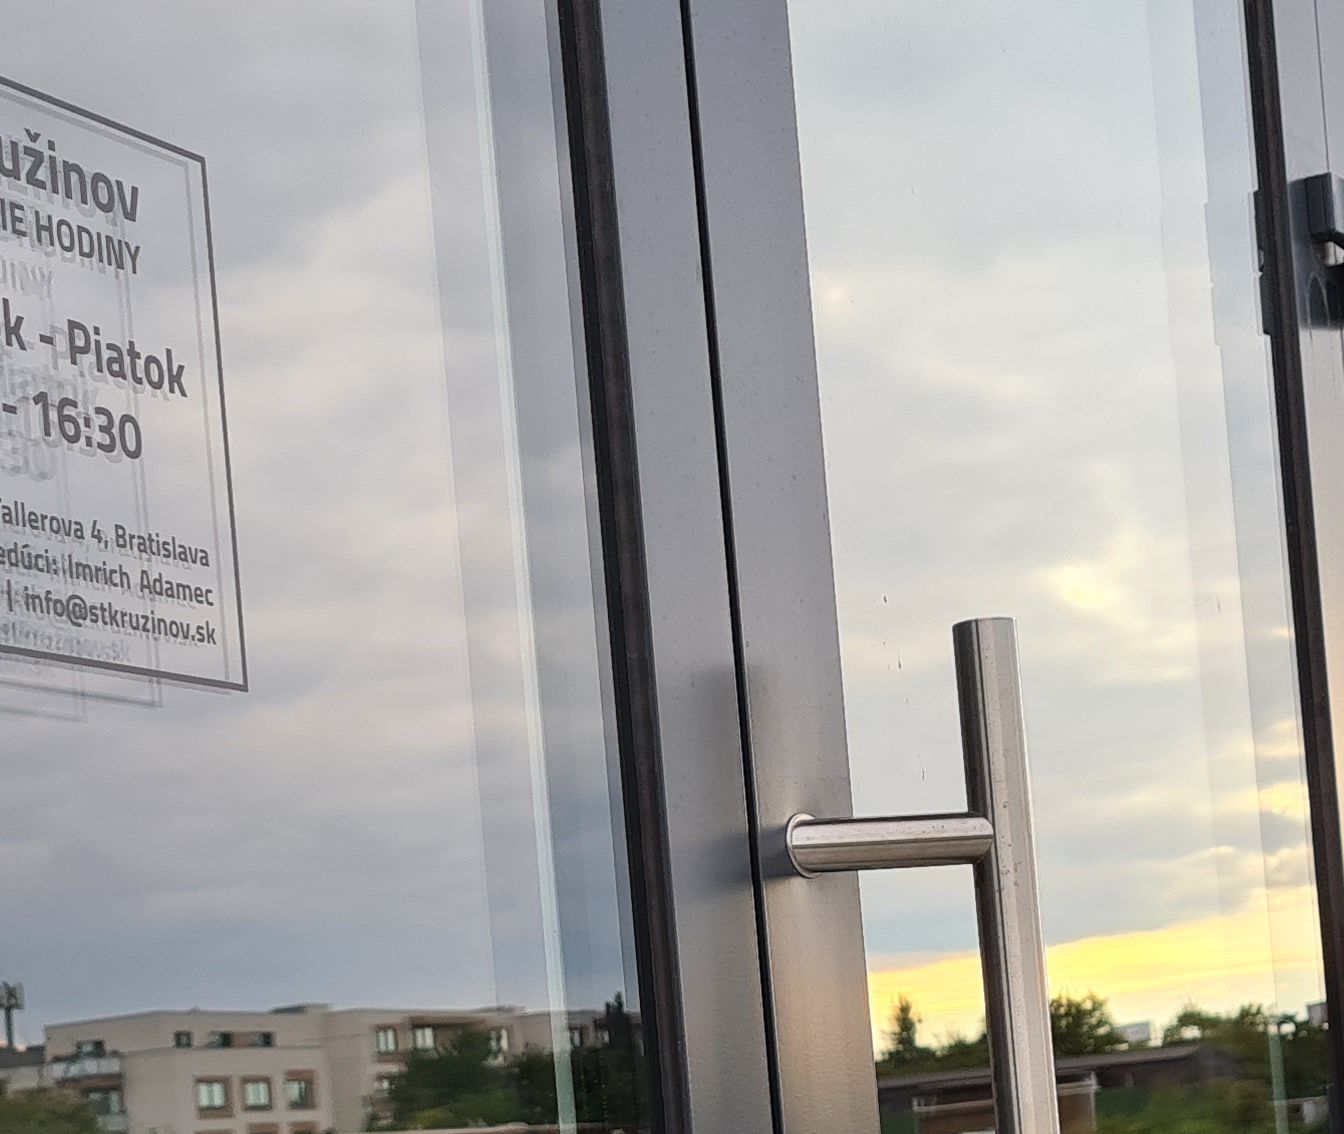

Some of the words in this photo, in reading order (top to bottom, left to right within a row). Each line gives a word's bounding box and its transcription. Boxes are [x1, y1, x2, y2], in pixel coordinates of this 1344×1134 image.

[35, 209, 142, 275] HODINY
[67, 318, 188, 398] Piatok
[32, 390, 143, 459] 16:30
[114, 524, 210, 567] Bratislava
[67, 554, 131, 591] Imrich
[139, 572, 214, 607] Adamec
[23, 585, 217, 646] info@stkruzinov.sk
